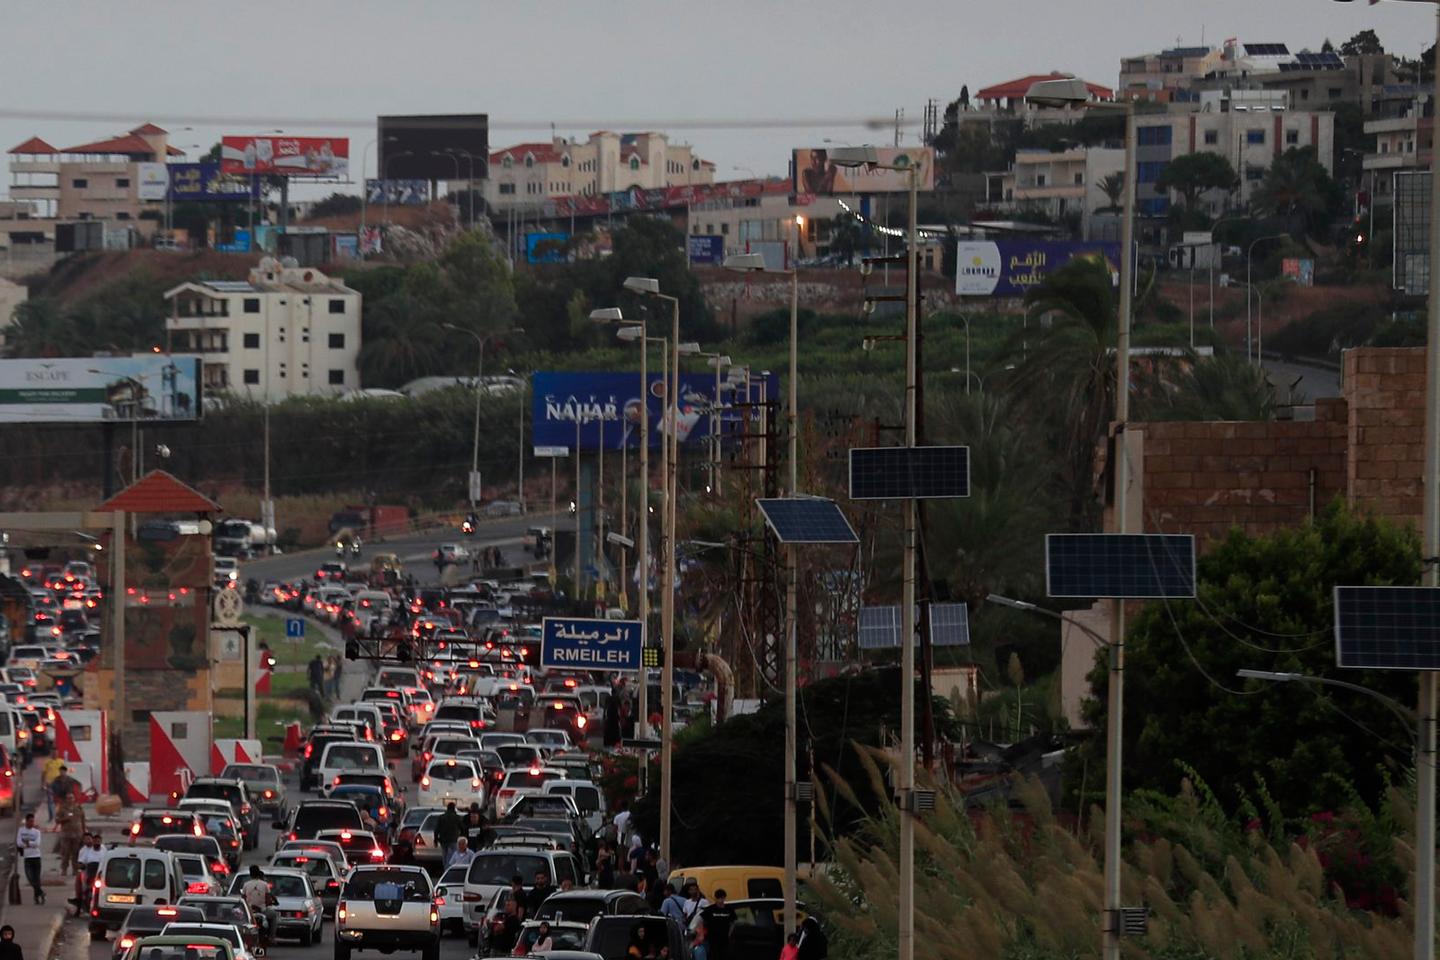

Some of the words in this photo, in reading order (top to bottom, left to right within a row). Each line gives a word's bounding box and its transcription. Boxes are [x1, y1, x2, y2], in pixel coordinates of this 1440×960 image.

[25, 371, 71, 382] ESCAPE
[546, 401, 618, 424] NAJJAR
[554, 623, 629, 645] الرميلة
[553, 648, 630, 664] RMEILEH
